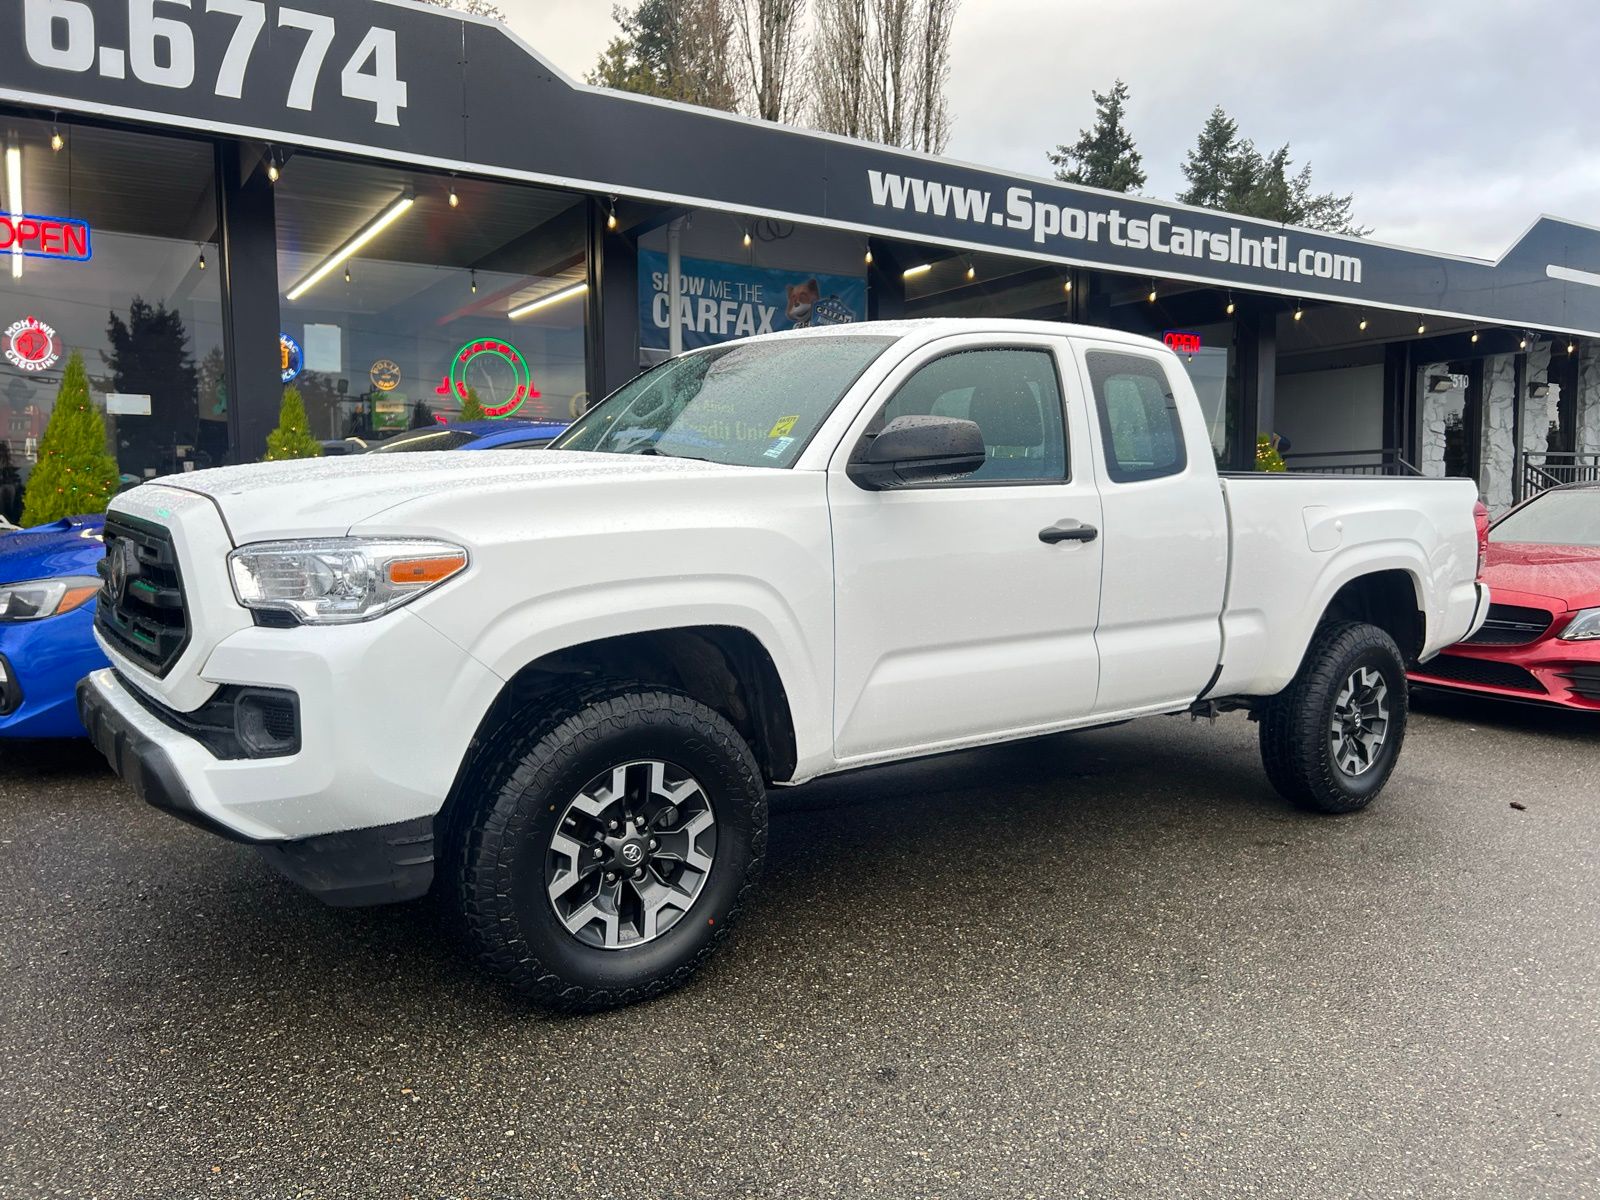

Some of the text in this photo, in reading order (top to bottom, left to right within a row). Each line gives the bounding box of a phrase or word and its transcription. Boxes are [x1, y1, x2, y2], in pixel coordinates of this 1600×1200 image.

[24, 0, 408, 127] 6.6774
[0, 217, 87, 257] OPEN
[867, 169, 1363, 284] www.SportsCarsIntl.com
[709, 279, 732, 300] ME
[735, 282, 763, 303] THE
[4, 319, 57, 338] MOHAWK
[652, 292, 776, 337] CARFAX
[1165, 332, 1201, 353] OPEN
[5, 350, 59, 371] GASOLINE
